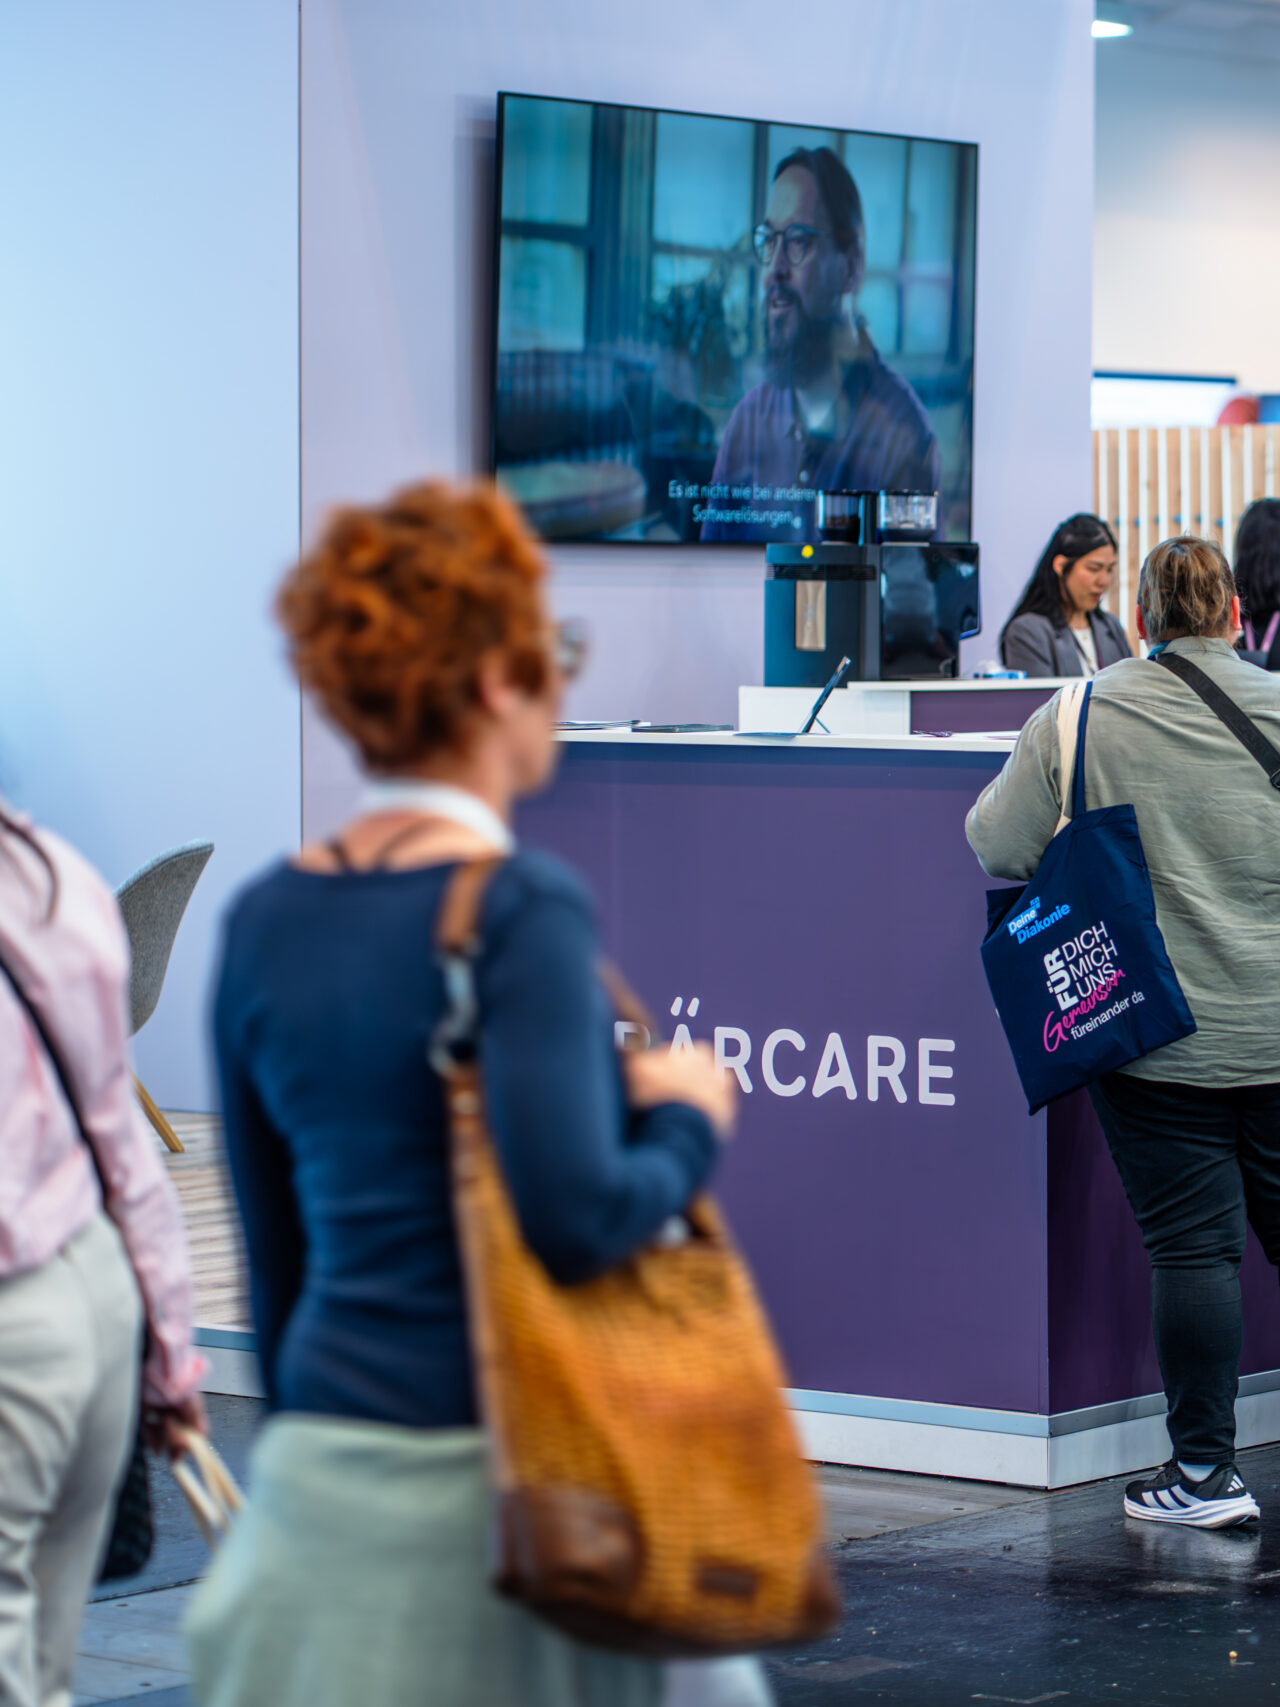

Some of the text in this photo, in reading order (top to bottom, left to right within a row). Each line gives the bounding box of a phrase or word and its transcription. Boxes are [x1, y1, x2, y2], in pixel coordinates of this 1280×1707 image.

[668, 480, 683, 498] Es
[685, 482, 699, 499] ist
[701, 482, 729, 499] nicht
[731, 484, 750, 500] wie
[753, 482, 772, 500] bei
[1009, 909, 1036, 933] Deine
[1016, 904, 1070, 944] Diakonie
[1061, 920, 1108, 962] DICH
[1043, 947, 1079, 1011] FÜR
[1068, 939, 1118, 980] MICH
[1076, 962, 1116, 998] UNS
[1043, 969, 1126, 1053] Gemeinsam
[1070, 991, 1146, 1040] füreinander da
